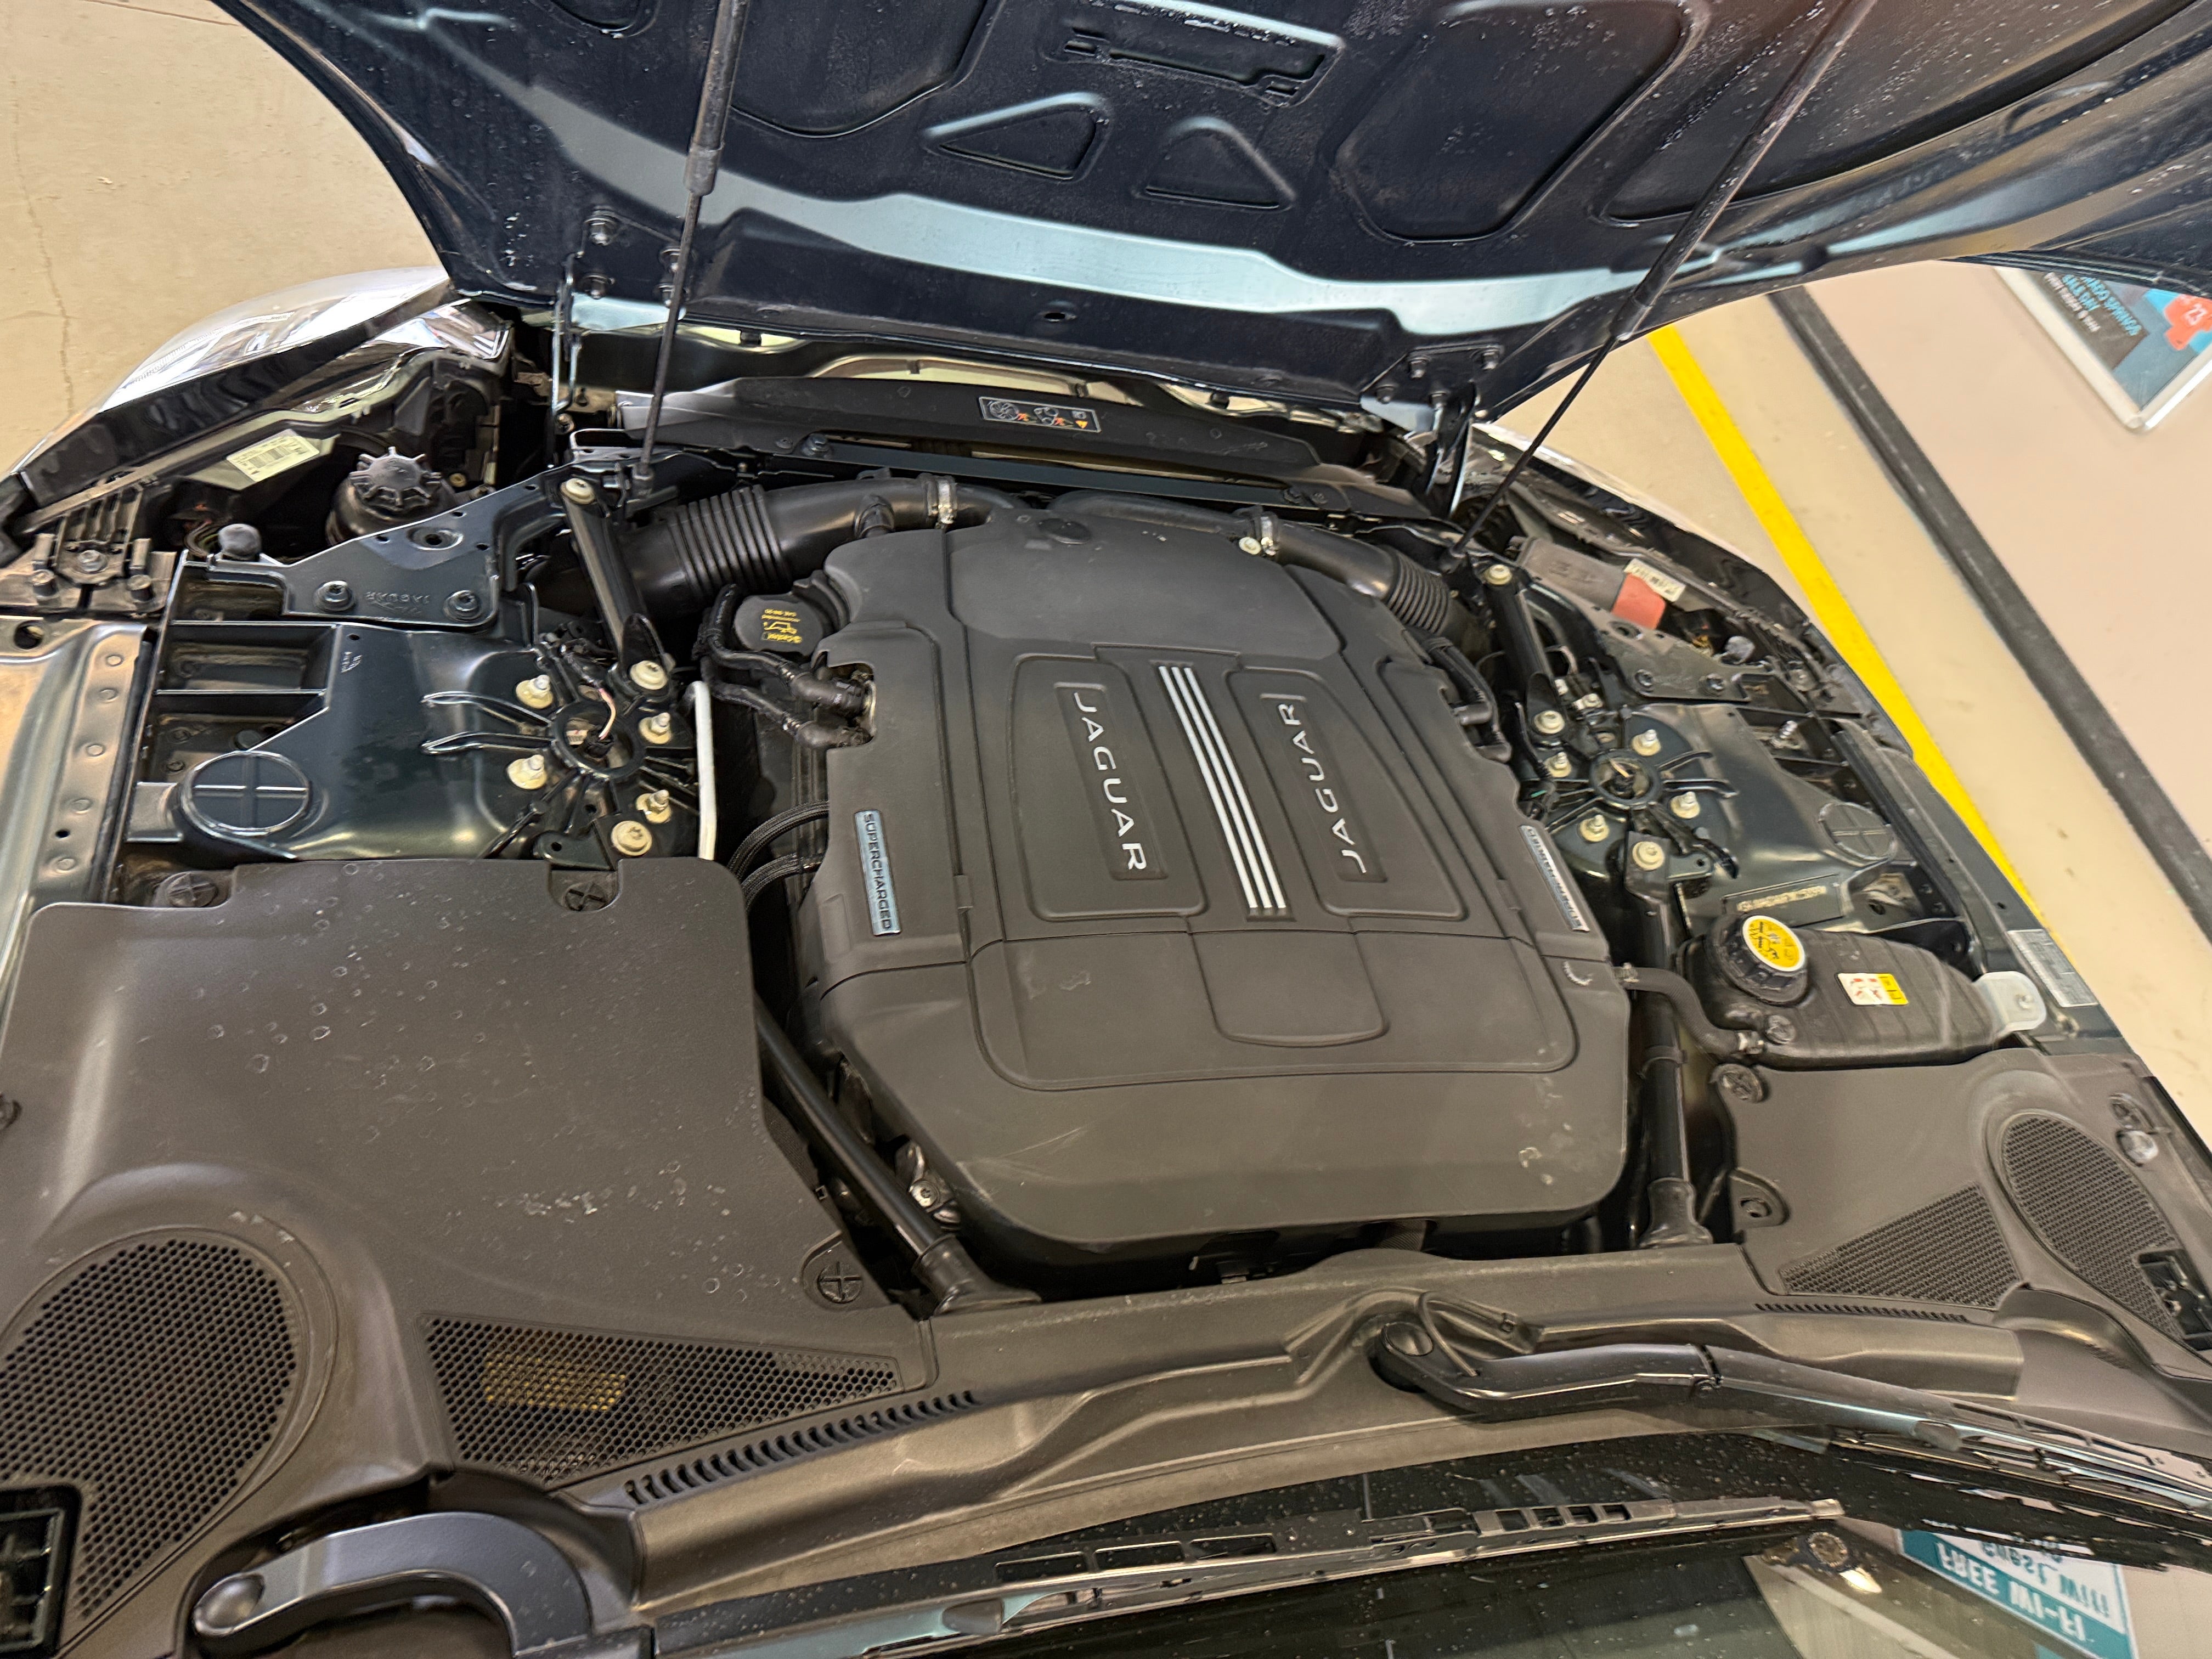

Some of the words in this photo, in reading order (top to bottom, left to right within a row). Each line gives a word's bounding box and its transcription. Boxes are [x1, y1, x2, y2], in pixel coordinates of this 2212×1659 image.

[2104, 297, 2142, 336] SPRINGS
[2184, 303, 2208, 326] 23
[1074, 692, 1147, 871] JAGUAR
[1277, 703, 1367, 873] JAGUAR
[864, 814, 892, 929] SUPERCHARGED
